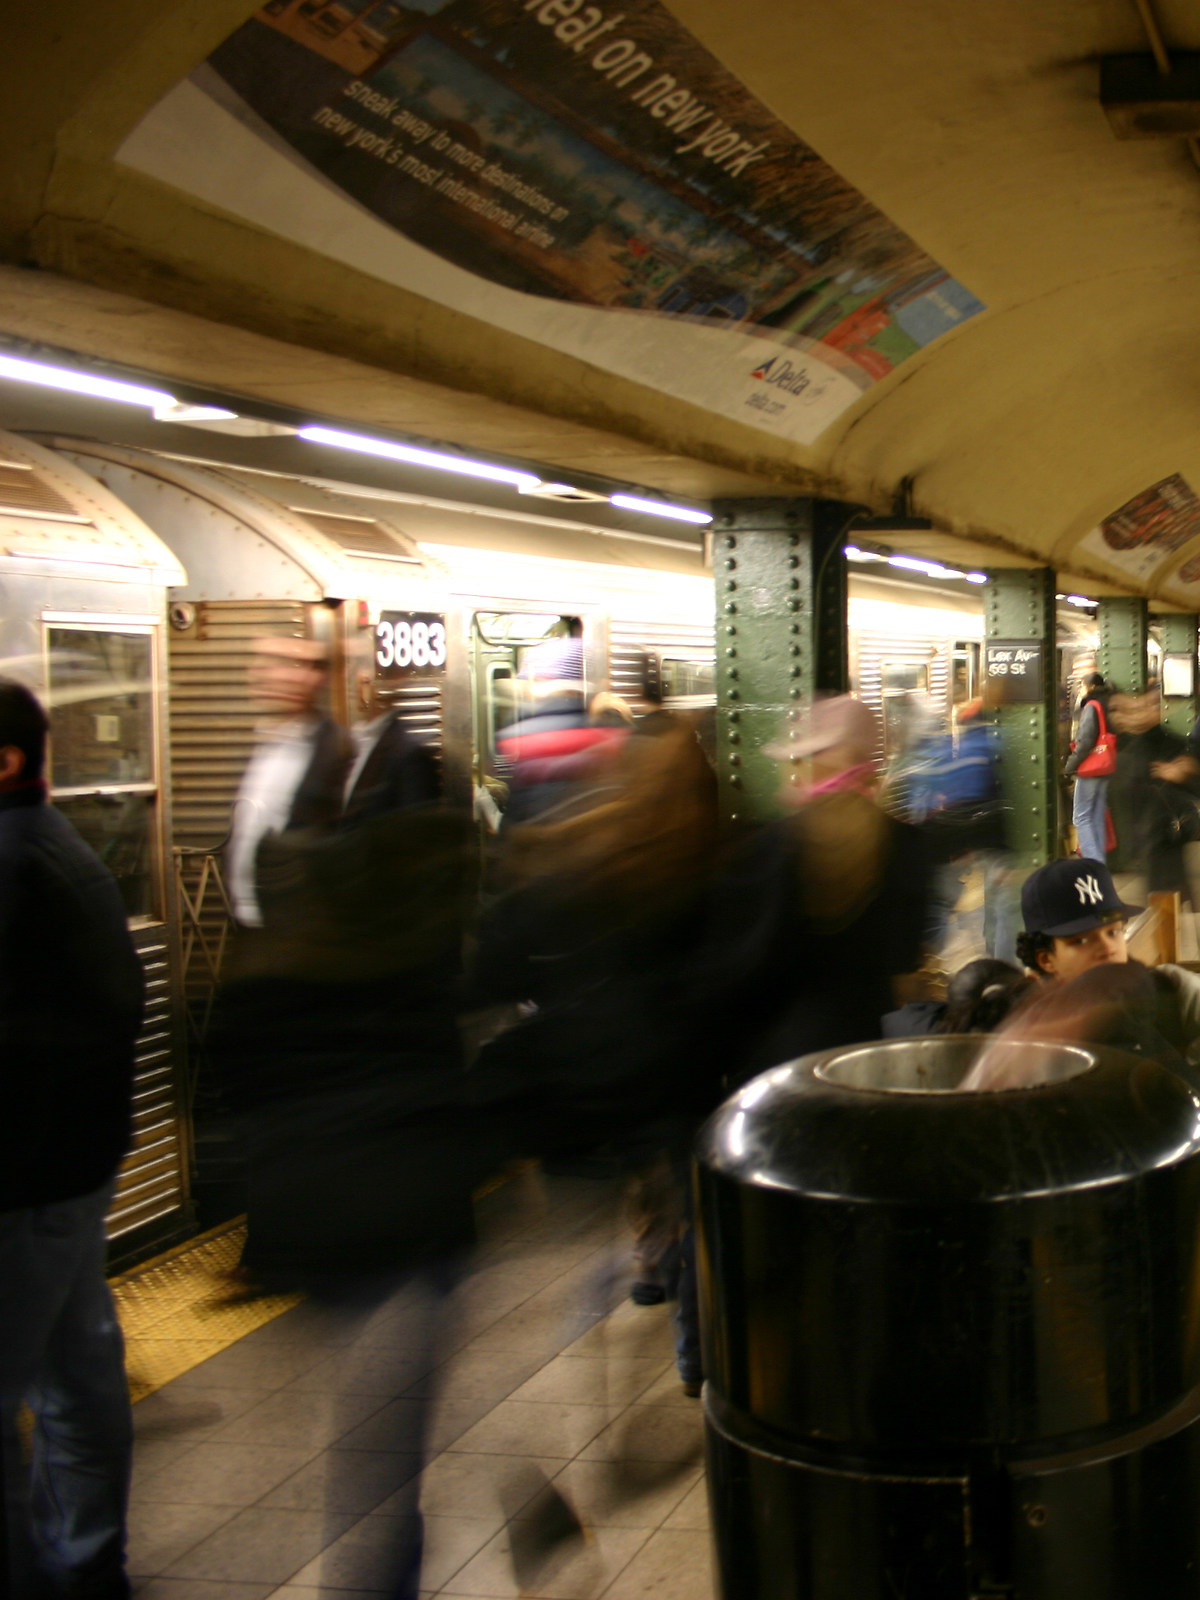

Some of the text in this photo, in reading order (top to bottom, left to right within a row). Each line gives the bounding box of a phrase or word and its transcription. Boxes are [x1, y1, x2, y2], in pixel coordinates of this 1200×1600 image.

[524, 0, 771, 178] eat on new york
[343, 80, 399, 119] sneak
[392, 110, 438, 145] away
[430, 130, 451, 151] to
[445, 143, 486, 172] more
[480, 162, 556, 215] destinations
[313, 107, 556, 249] new york's most international airline
[765, 360, 811, 396] Delta
[376, 620, 447, 668] 3883
[988, 649, 1012, 662] Lex
[988, 663, 1026, 676] 59 St
[1074, 874, 1104, 905] NY
